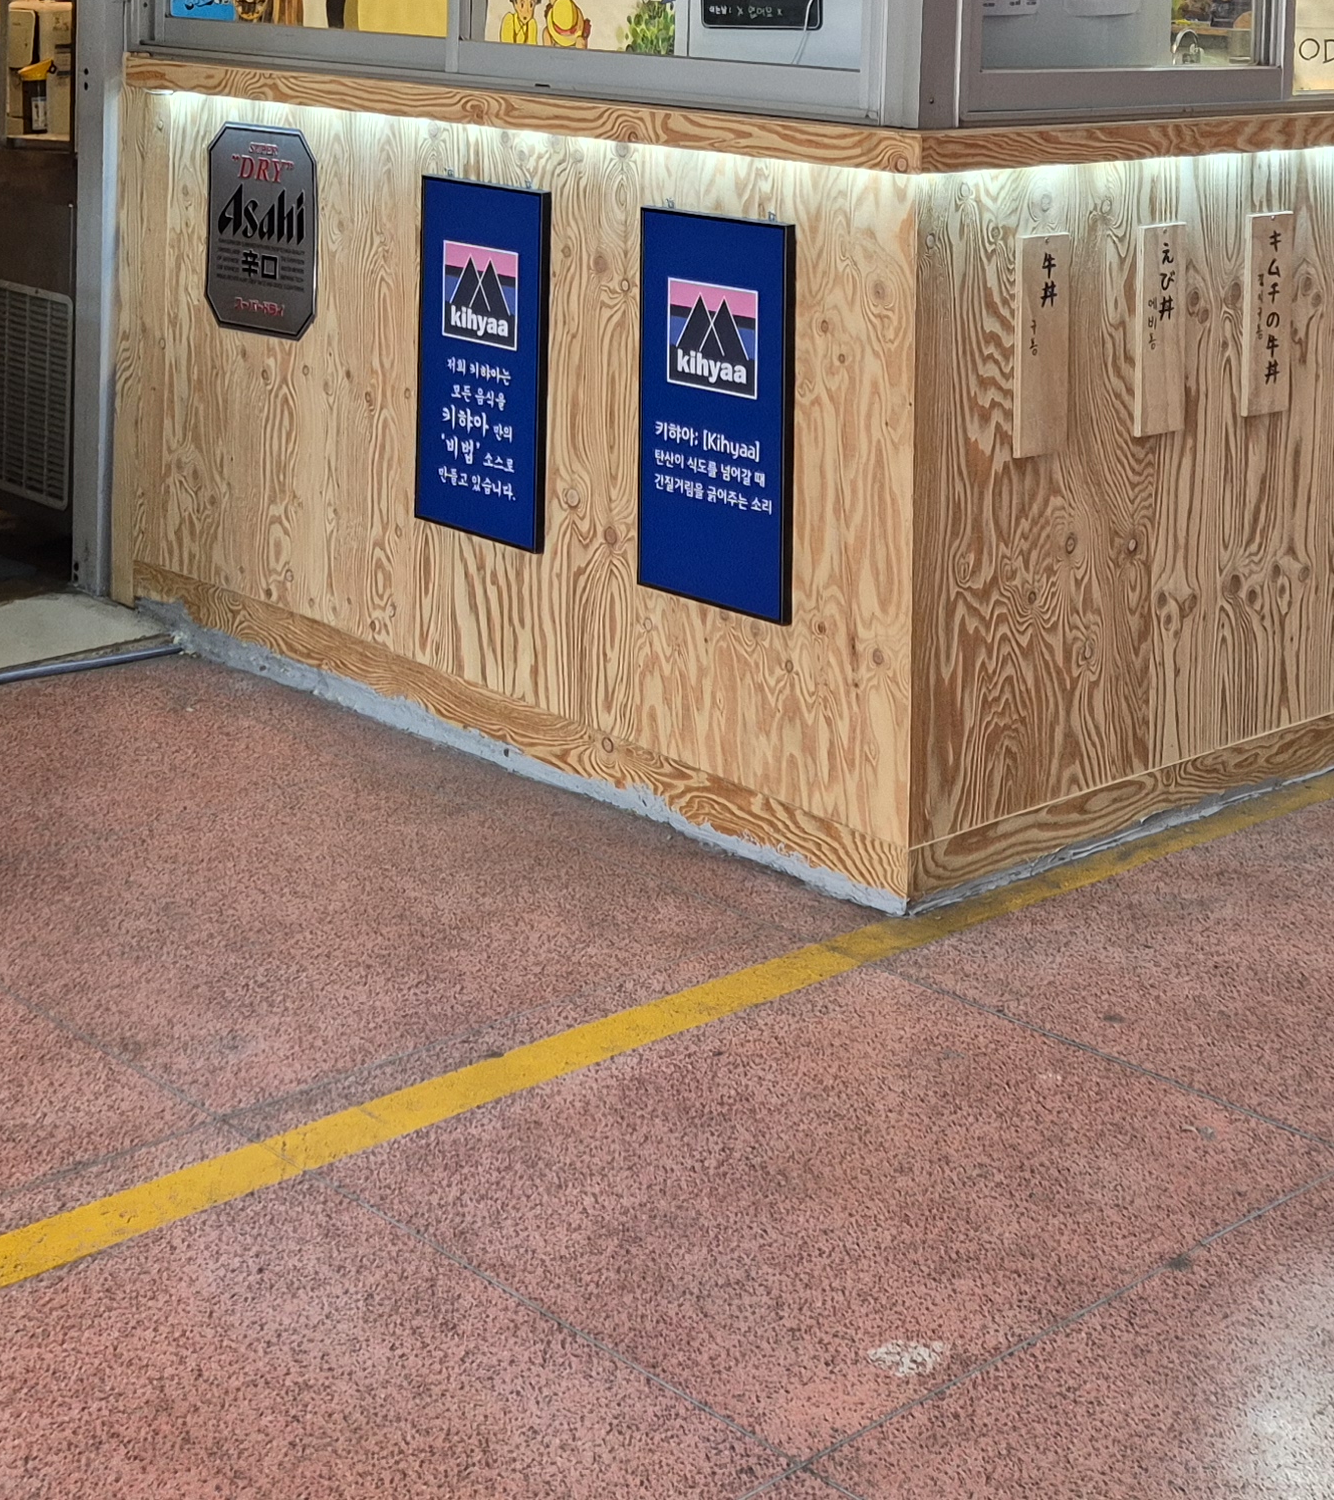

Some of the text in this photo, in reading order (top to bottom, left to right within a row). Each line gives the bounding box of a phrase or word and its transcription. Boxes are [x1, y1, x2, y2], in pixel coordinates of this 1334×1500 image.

[217, 183, 306, 246] Asahi
[241, 249, 279, 281] 辛口
[1040, 251, 1058, 308] 牛丼
[1158, 242, 1176, 322] えび丼
[450, 304, 510, 339] kihyaa
[1264, 230, 1283, 385] キムチの牛丼
[446, 356, 512, 386] 저희 키햐아는
[676, 348, 747, 387] kihyaa
[451, 383, 507, 411] 모든 음식을
[441, 403, 513, 443] 키햐아 만의
[482, 451, 515, 474] 소스로
[702, 428, 761, 463] [Kihyaa]
[438, 465, 469, 488] 만들고
[654, 448, 766, 488] 탄산이 식도를 넘어갈 때
[654, 472, 773, 516] 간질거림을 긁어주는 소리
